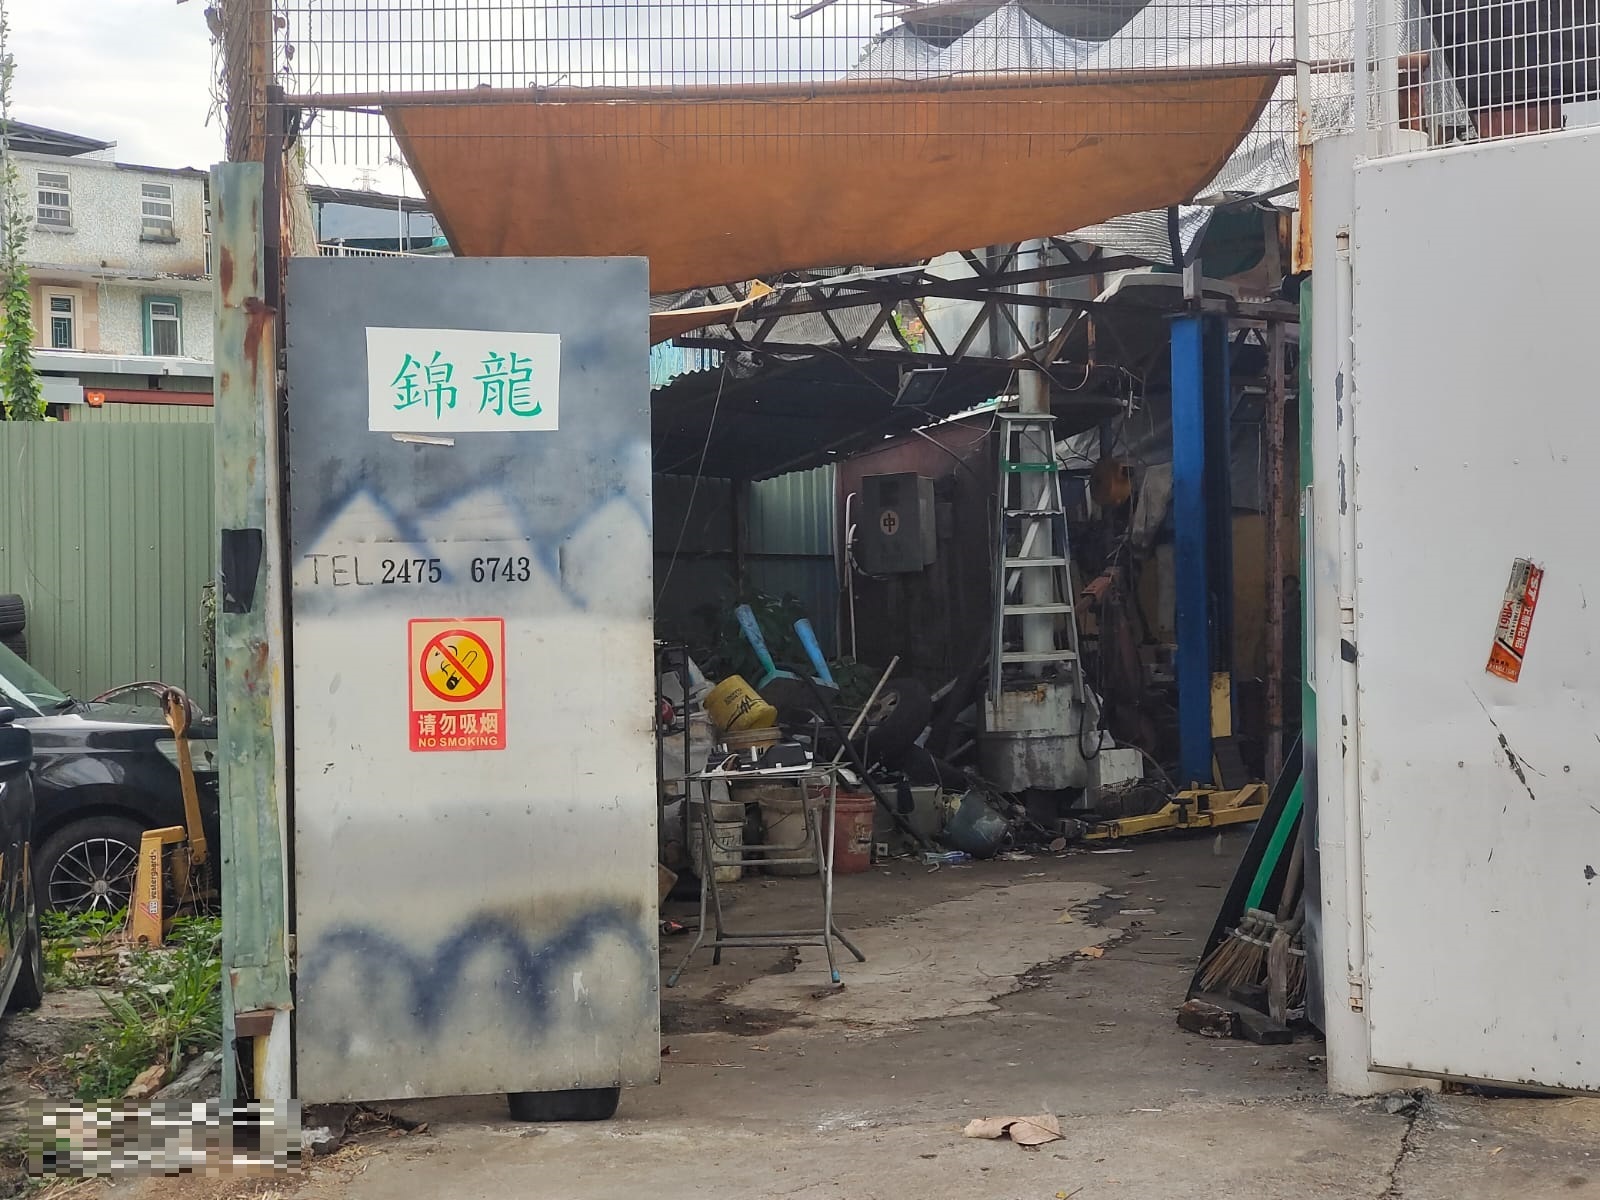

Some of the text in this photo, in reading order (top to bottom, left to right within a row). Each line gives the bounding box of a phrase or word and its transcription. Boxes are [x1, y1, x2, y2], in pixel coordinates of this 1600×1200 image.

[390, 351, 543, 420] 錦龍
[883, 512, 896, 532] 中
[303, 554, 531, 586] TEL 2475 6743
[1500, 600, 1514, 630] MR61
[418, 713, 499, 735] 请勿吸烟
[418, 736, 498, 748] NO SMOKING
